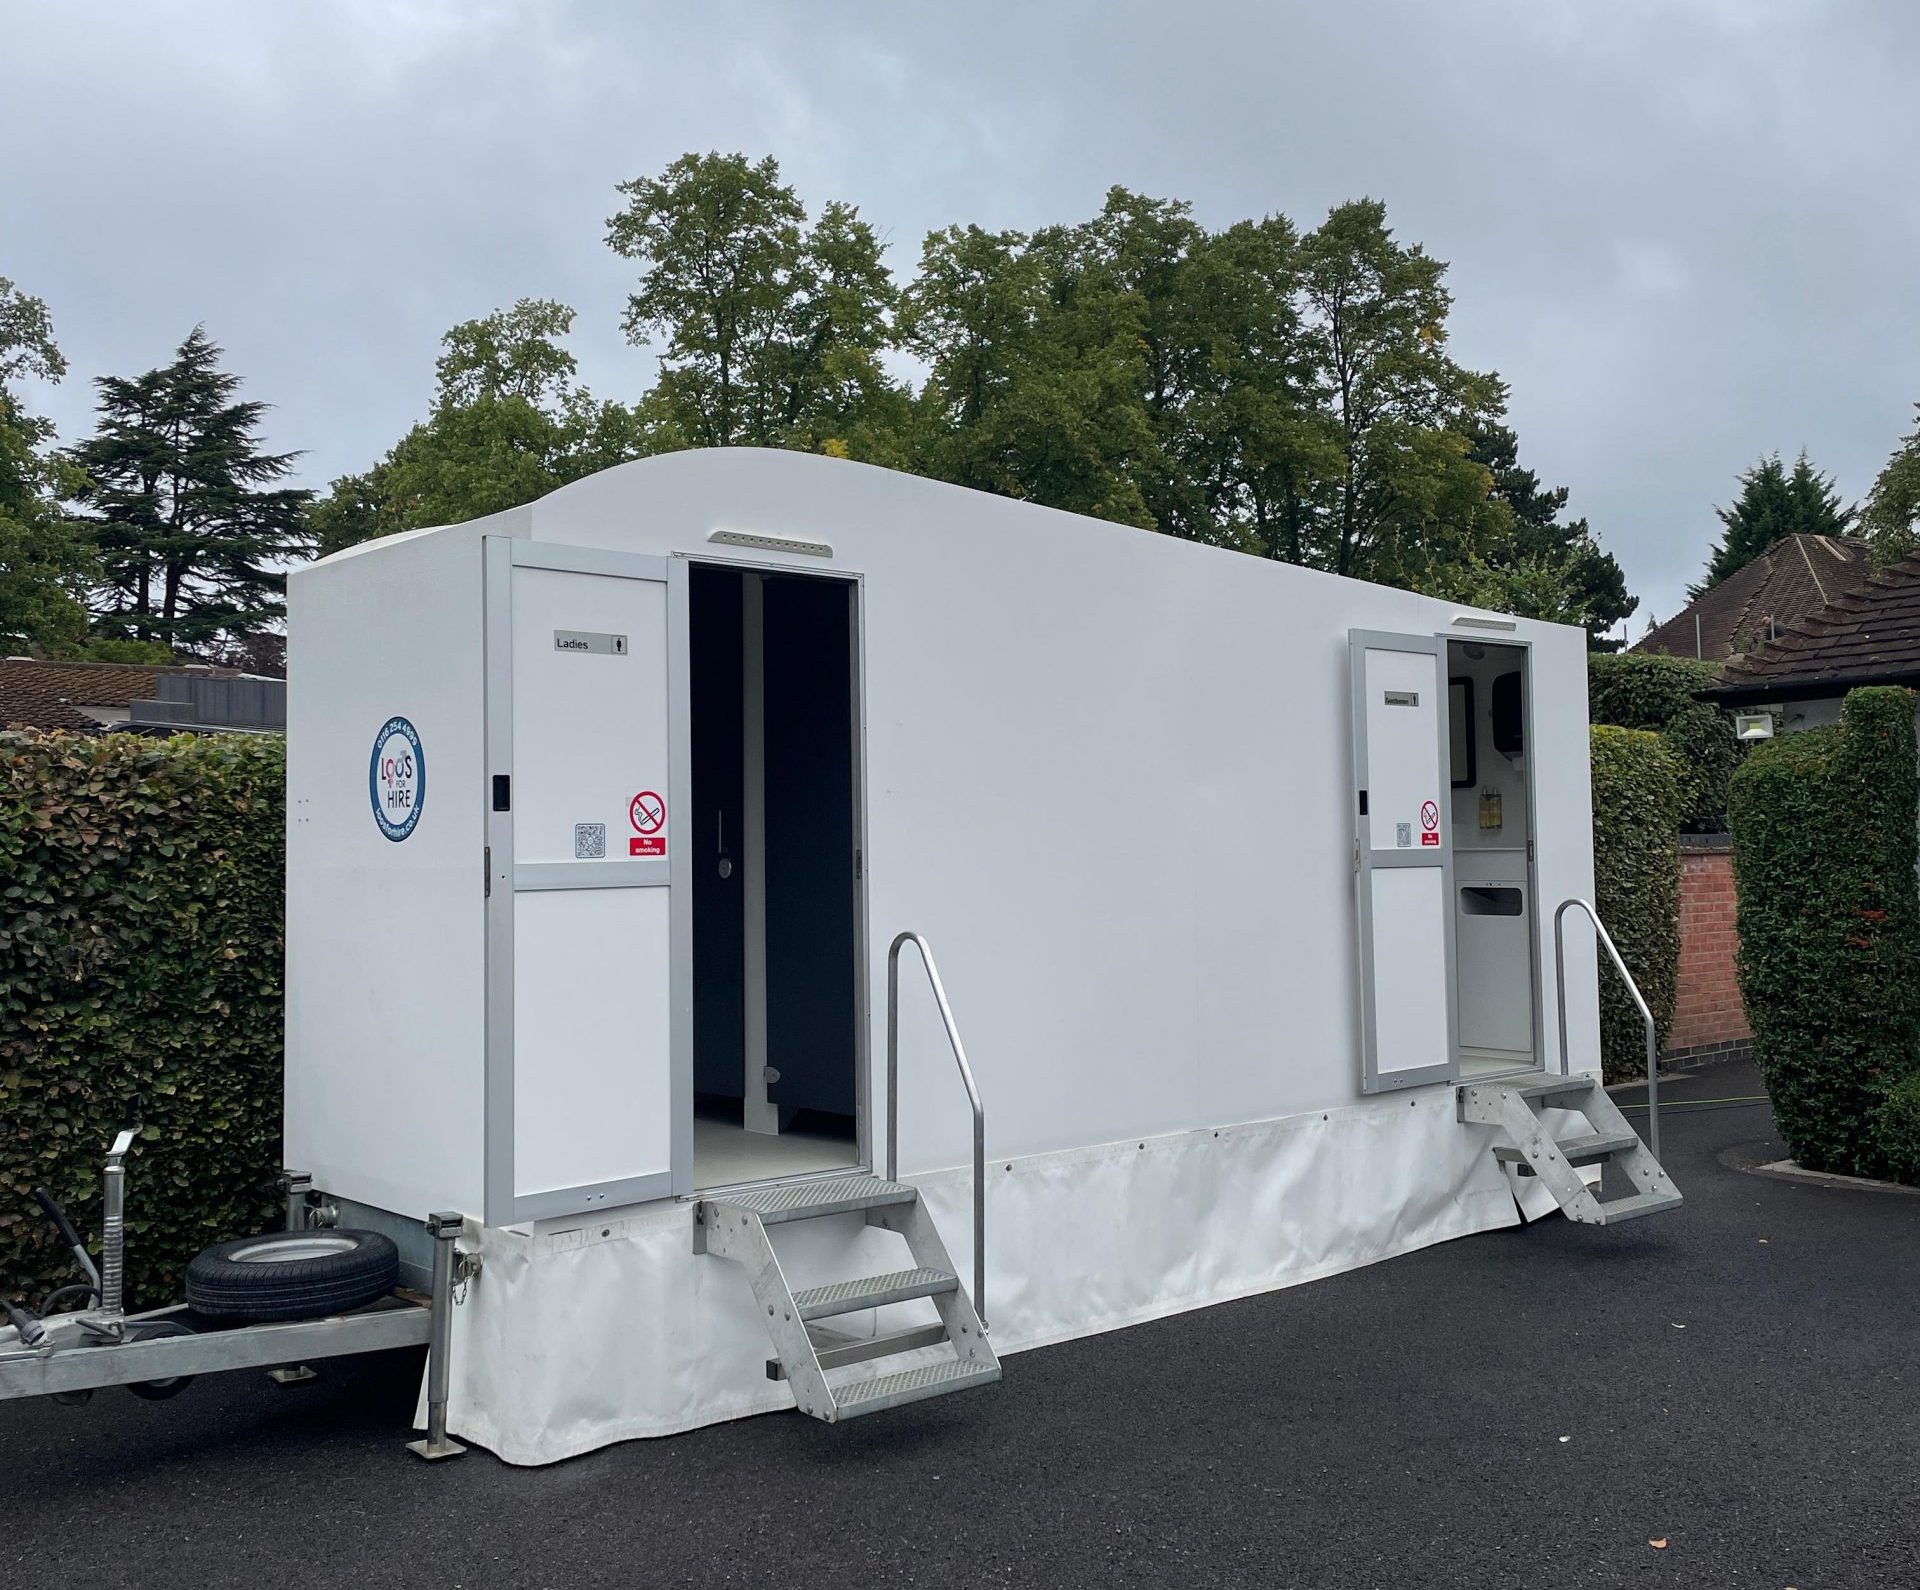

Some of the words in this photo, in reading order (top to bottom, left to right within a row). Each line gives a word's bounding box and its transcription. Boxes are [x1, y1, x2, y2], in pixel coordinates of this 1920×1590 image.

[556, 638, 589, 650] Ladies
[377, 727, 390, 749] 0116
[389, 721, 402, 733] 254
[401, 723, 418, 746] 4999
[381, 755, 412, 780] LOOS
[395, 779, 406, 788] FOR
[387, 789, 411, 809] HIRE
